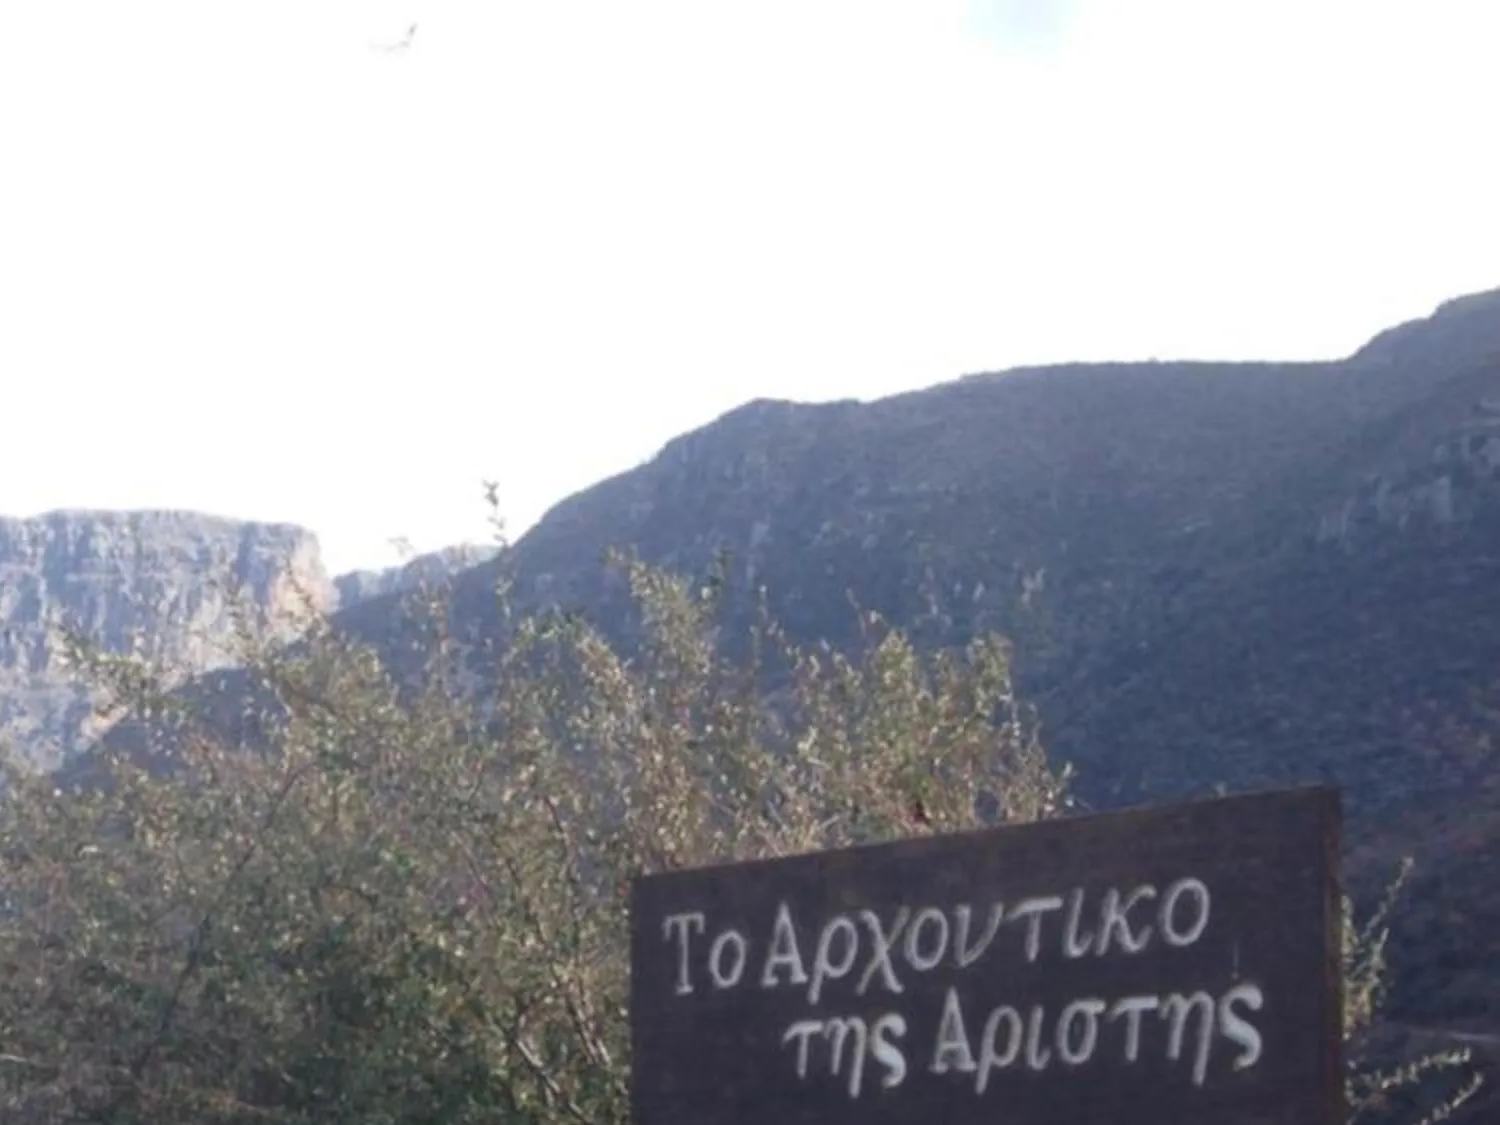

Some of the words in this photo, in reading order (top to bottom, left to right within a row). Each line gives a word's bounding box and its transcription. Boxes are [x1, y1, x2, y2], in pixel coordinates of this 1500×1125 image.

[664, 911, 747, 995] Το
[783, 1011, 908, 1098] της
[929, 984, 1265, 1094] Αριστης
